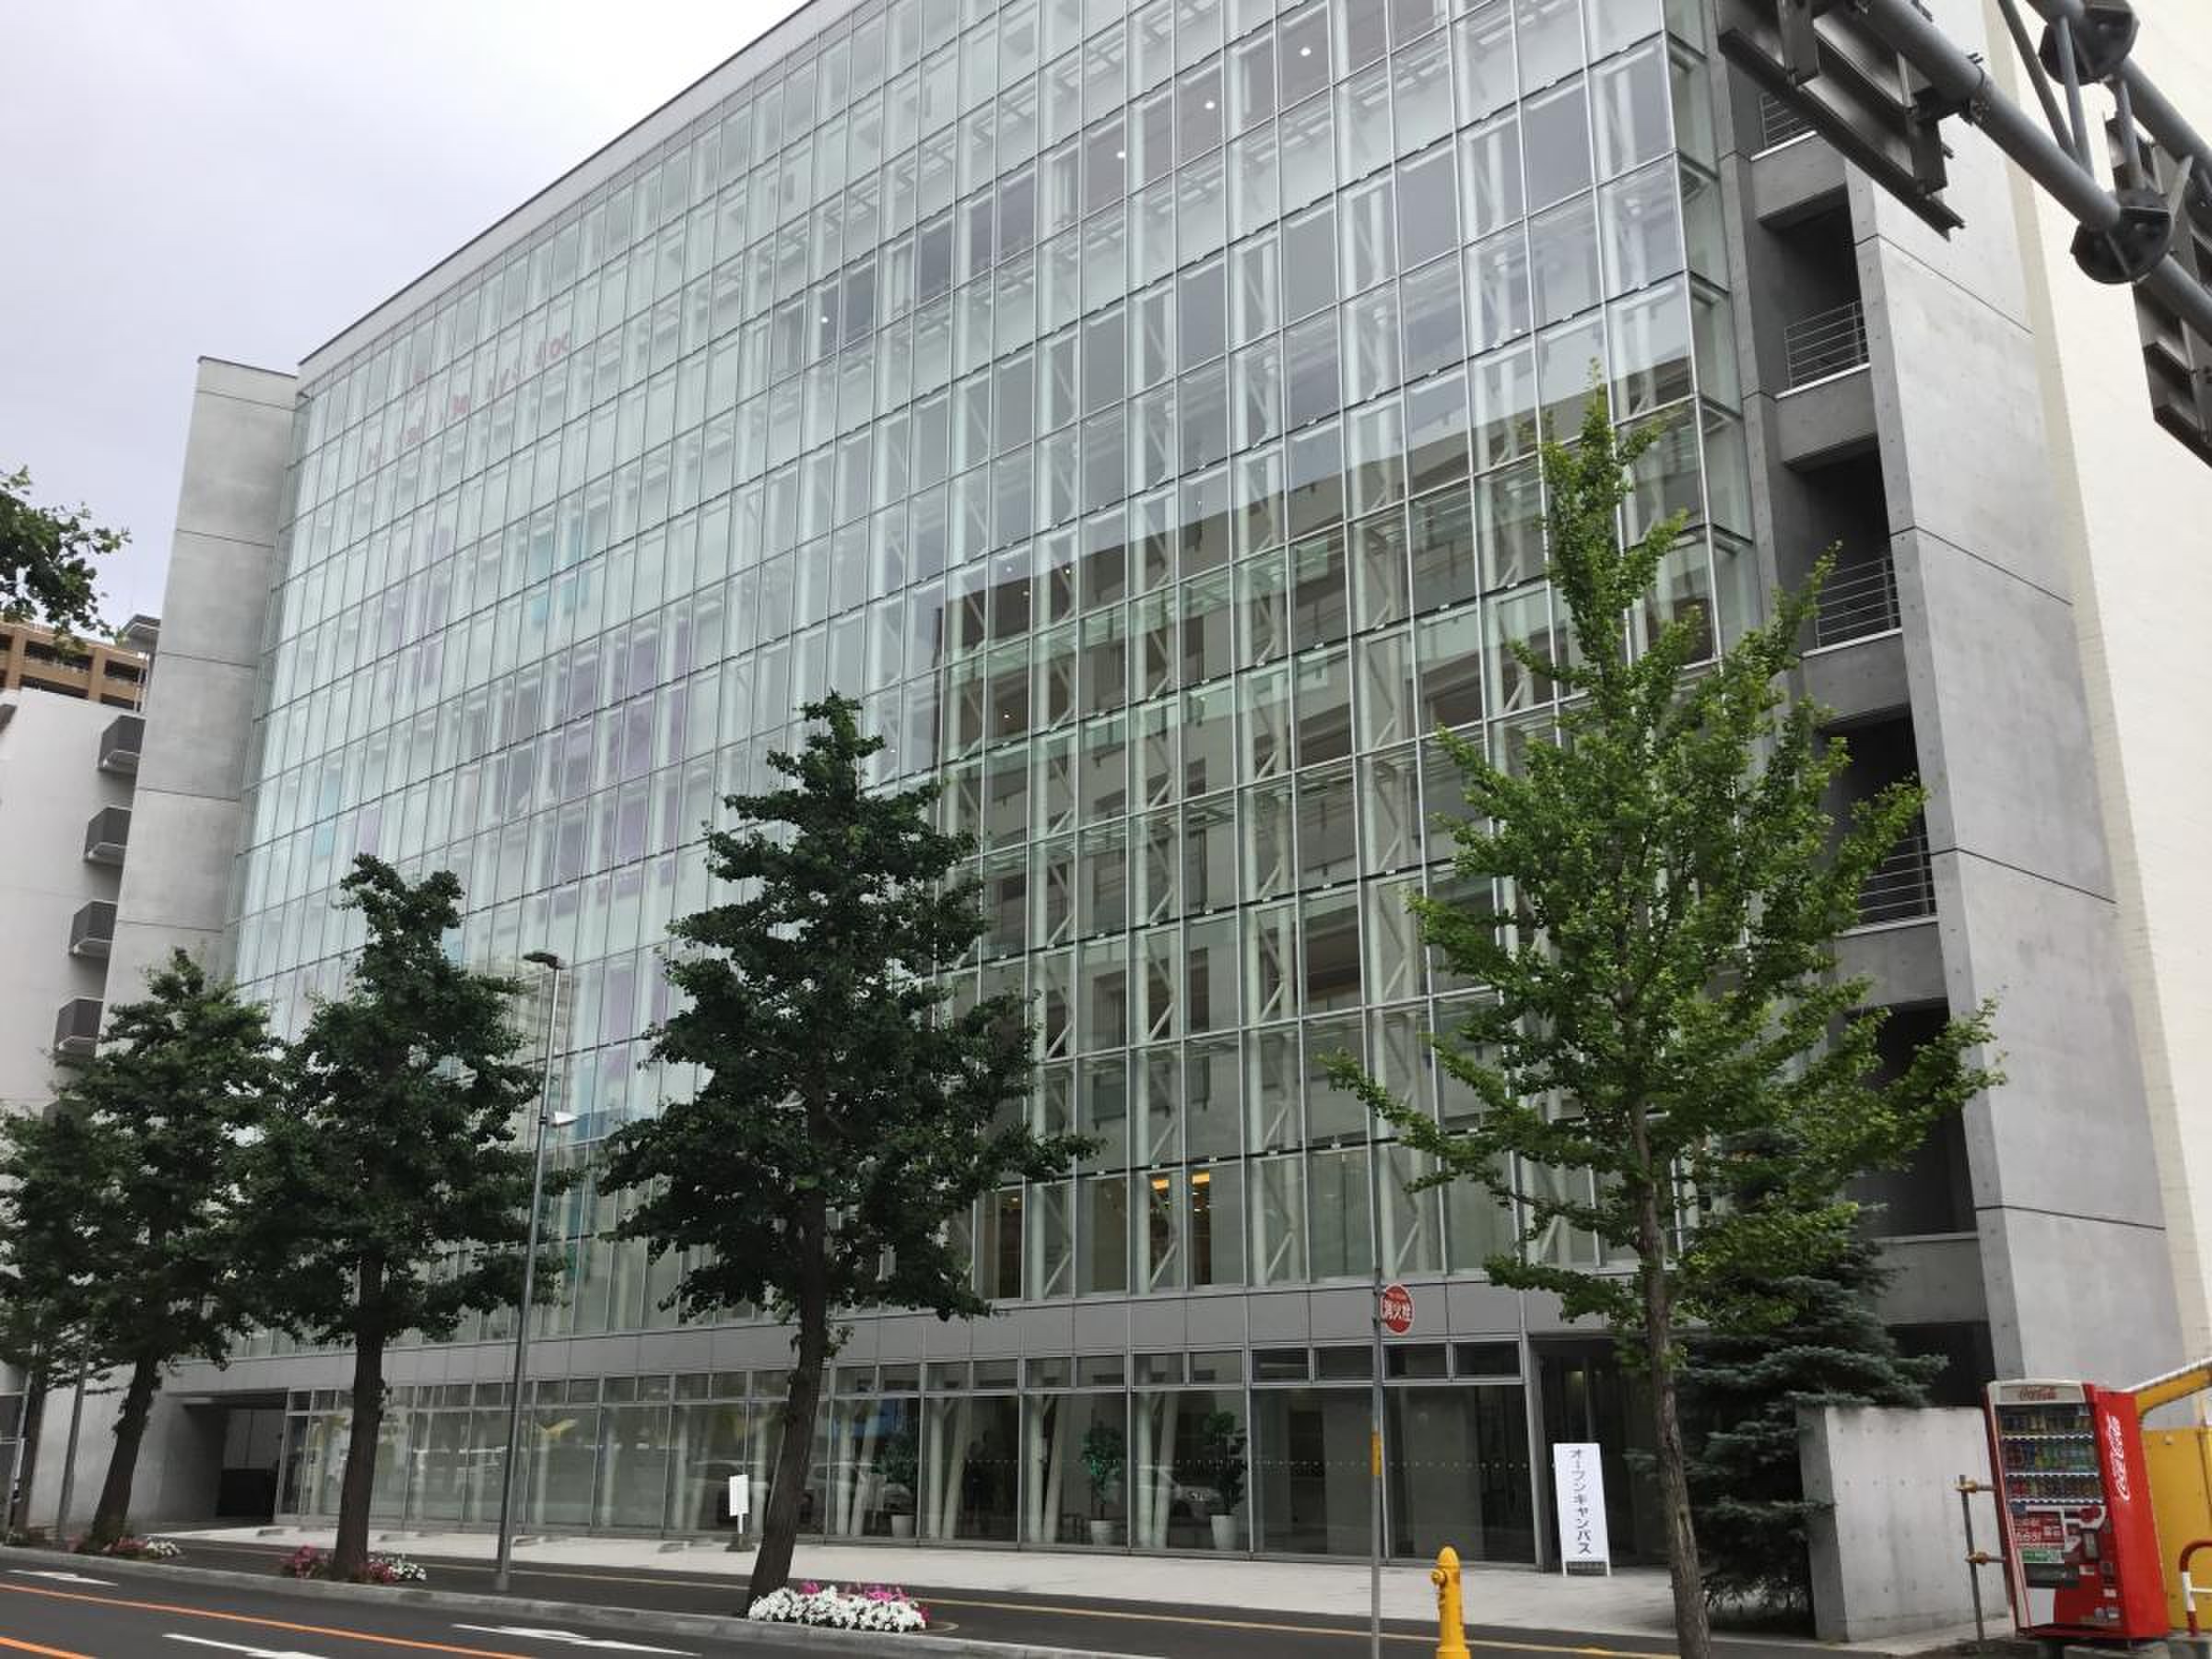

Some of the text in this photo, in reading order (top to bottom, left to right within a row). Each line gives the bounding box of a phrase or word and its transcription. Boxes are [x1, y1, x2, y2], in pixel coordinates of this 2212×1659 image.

[1569, 1448, 1592, 1555] オープンキャンパス
